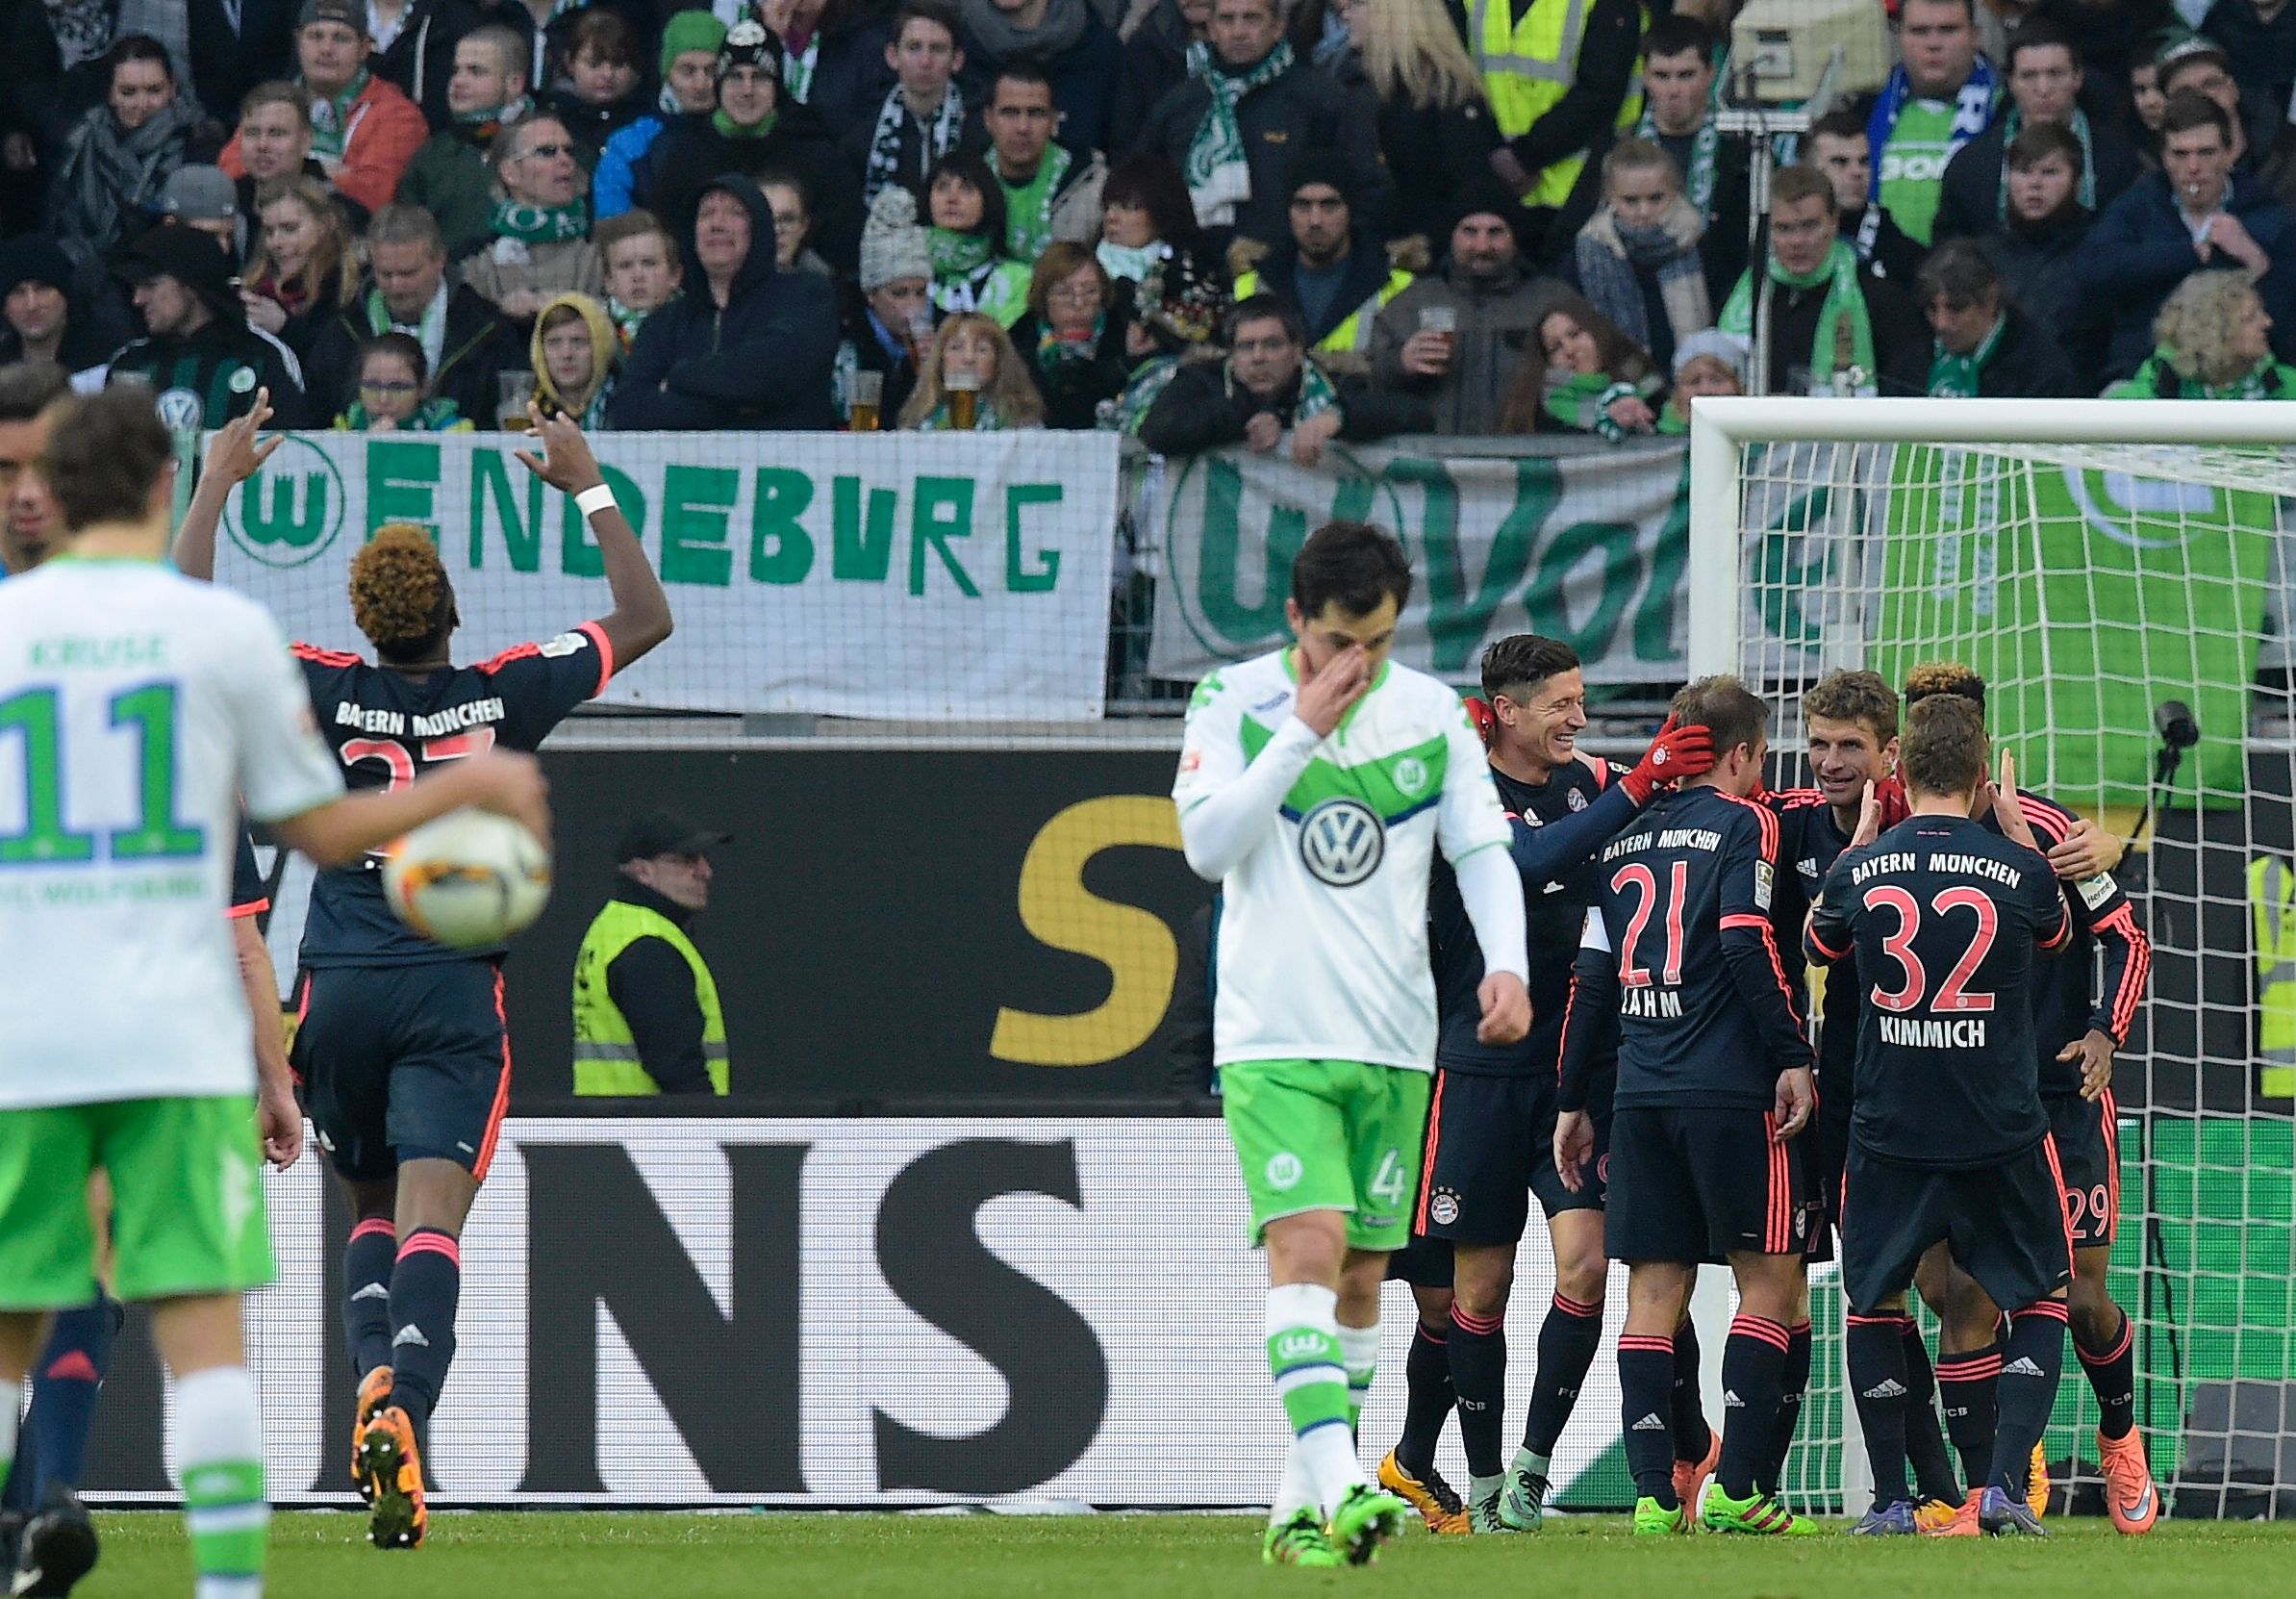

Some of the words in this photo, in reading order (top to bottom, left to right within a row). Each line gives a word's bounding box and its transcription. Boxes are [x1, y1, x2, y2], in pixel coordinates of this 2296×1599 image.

[0, 679, 206, 864] 11
[1603, 830, 1653, 863] BAYERN
[1852, 852, 1916, 886] BAYERN
[1928, 852, 2022, 890] MÜNCHEN
[1610, 860, 1688, 989] 21
[1862, 884, 1999, 1013] 32
[1879, 1015, 1986, 1049] KIMMICH
[1371, 1148, 1406, 1206] 4
[2064, 1183, 2109, 1238] 29
[1457, 1395, 1486, 1411] FCB
